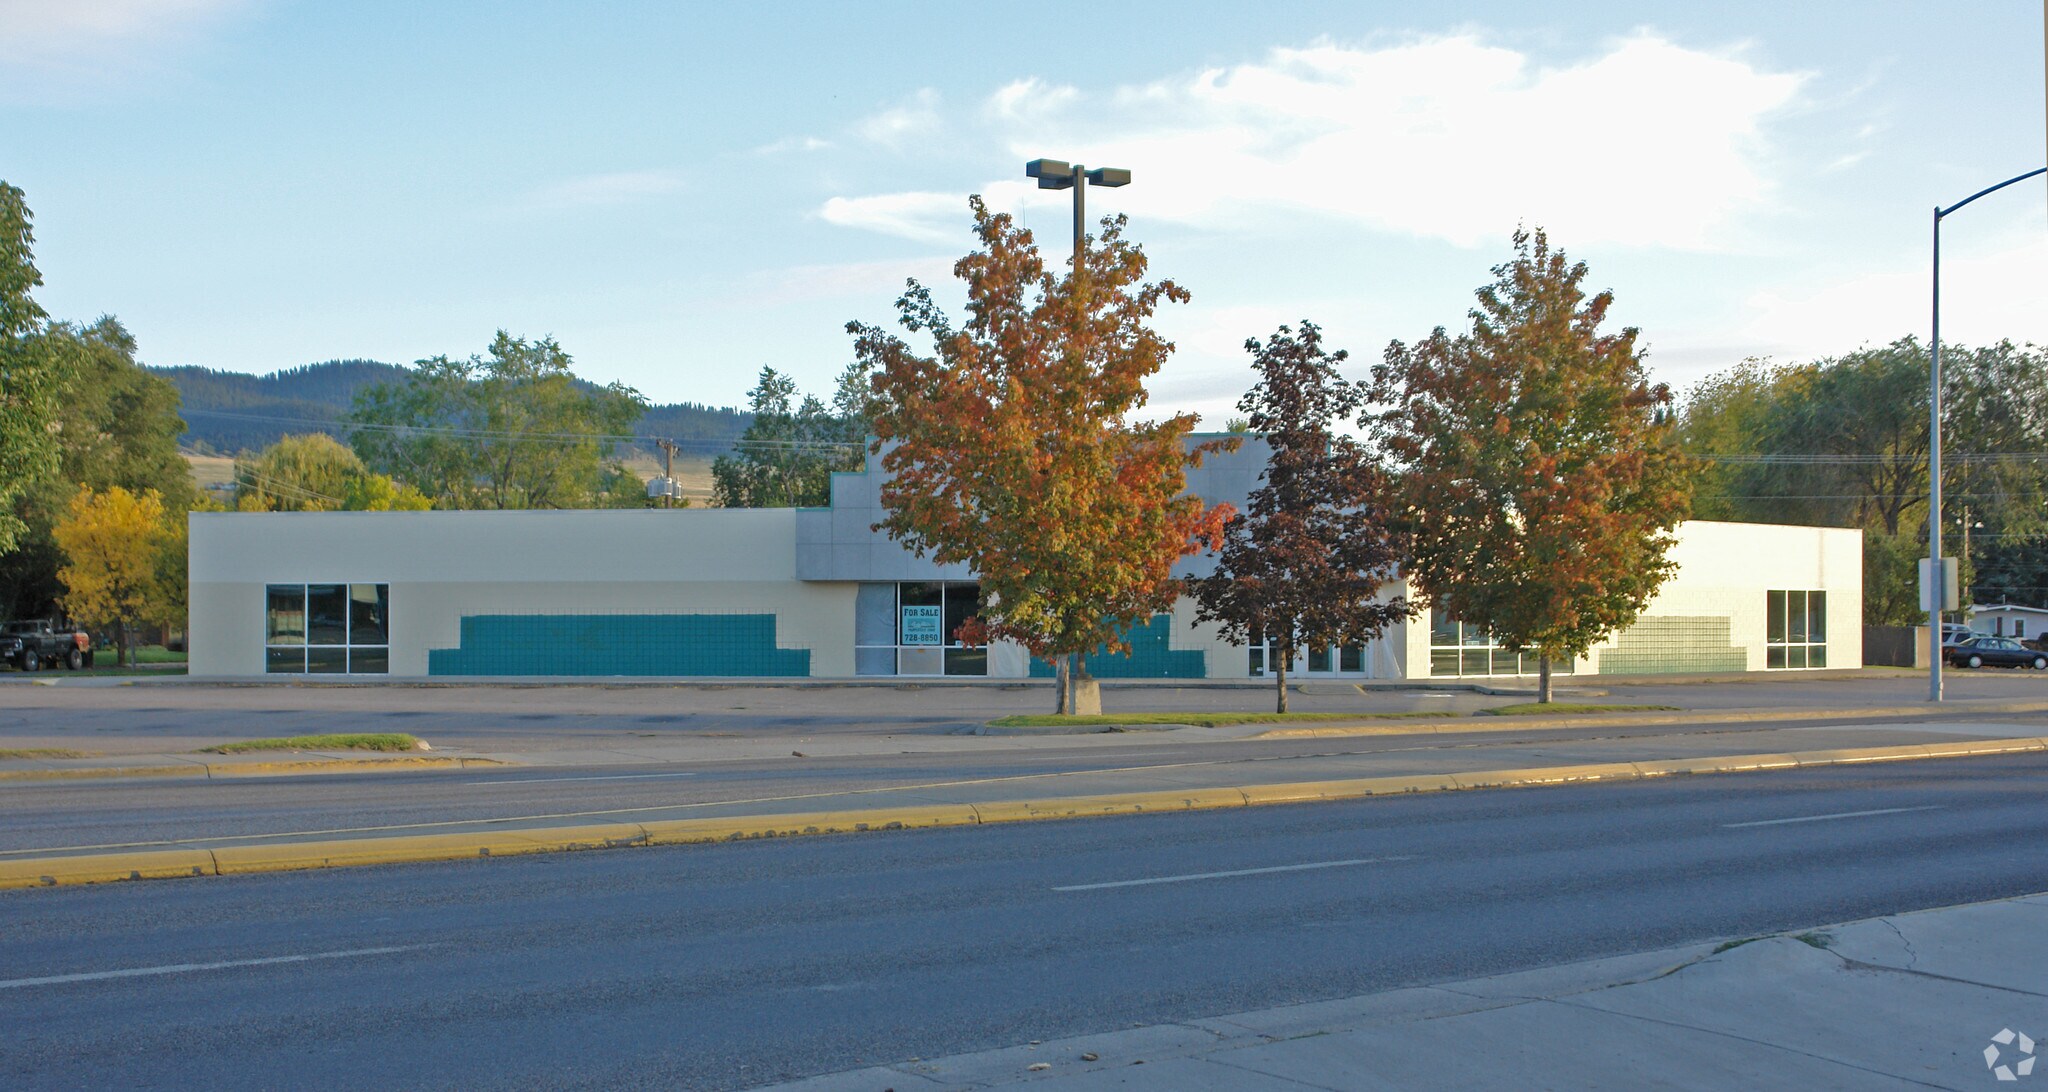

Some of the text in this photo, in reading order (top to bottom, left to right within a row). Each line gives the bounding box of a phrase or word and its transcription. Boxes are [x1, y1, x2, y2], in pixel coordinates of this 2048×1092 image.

[904, 608, 939, 616] FOR SALE
[905, 634, 938, 642] 728-8850
